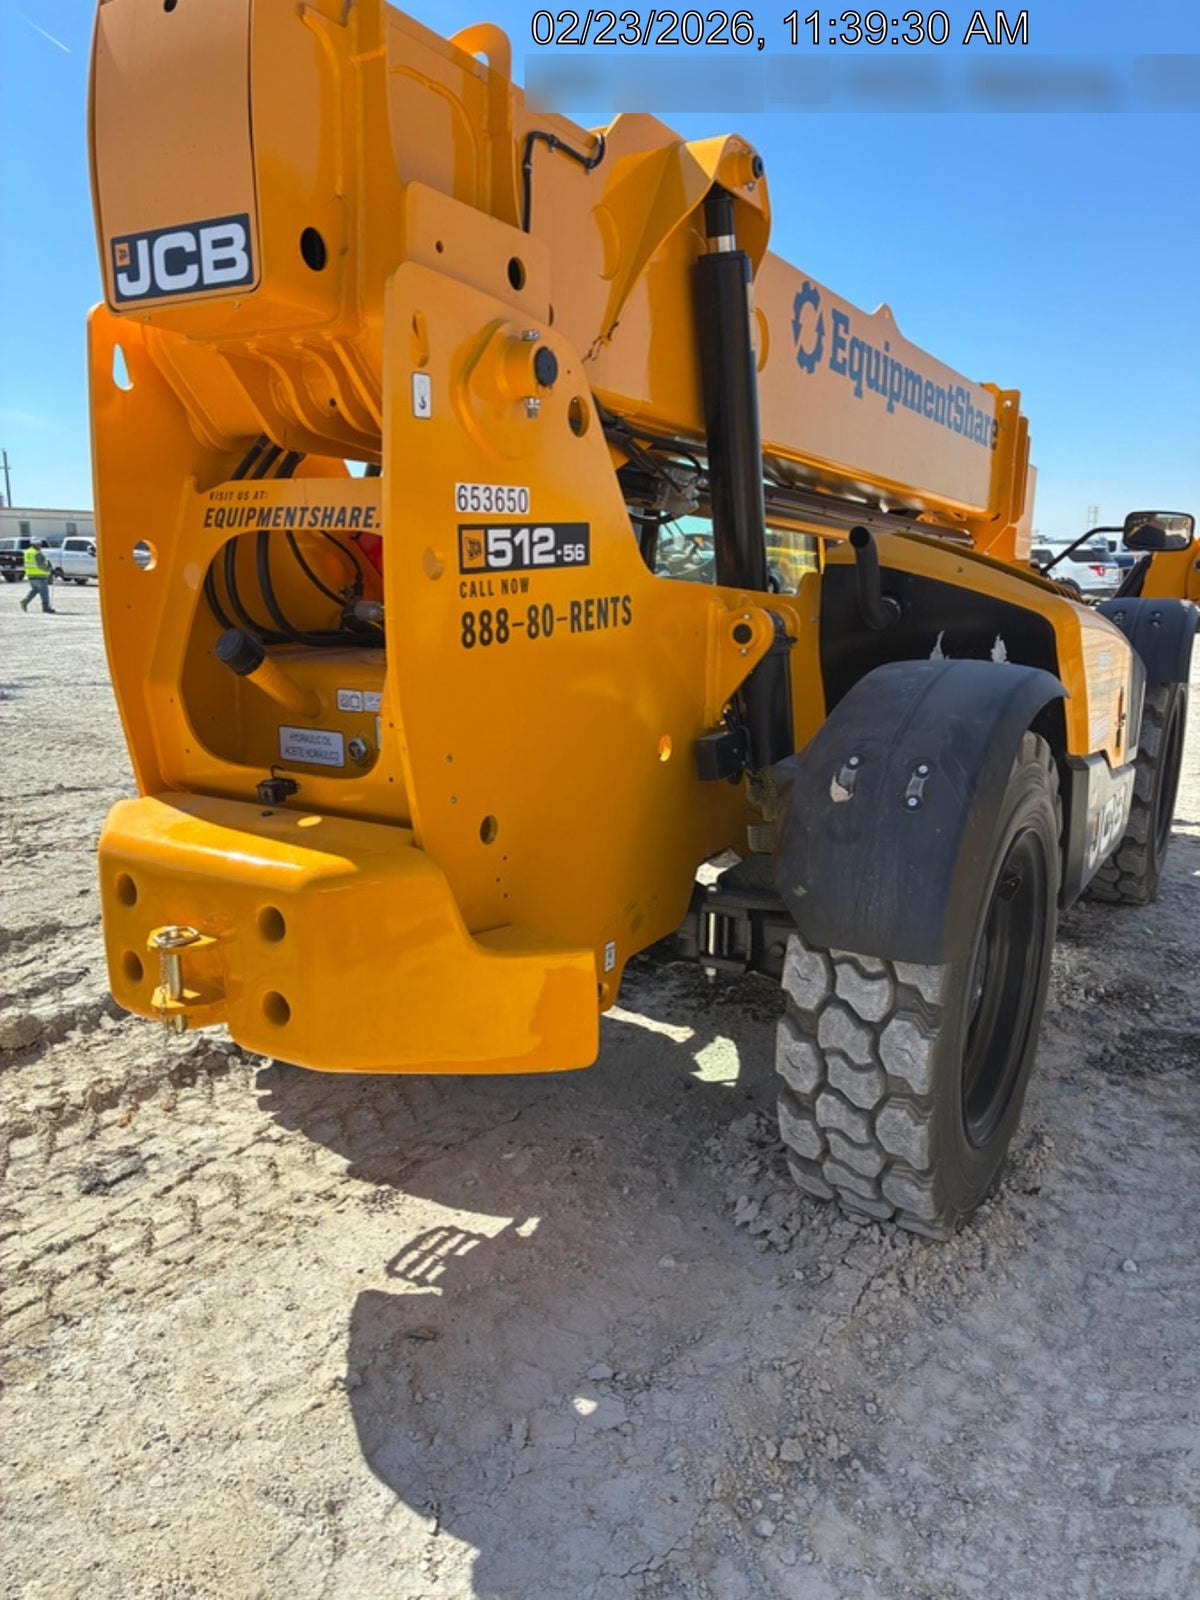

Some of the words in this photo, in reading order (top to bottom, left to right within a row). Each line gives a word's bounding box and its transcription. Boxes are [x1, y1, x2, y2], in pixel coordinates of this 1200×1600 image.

[117, 223, 249, 296] JCB
[829, 307, 999, 450] EquipmentShare
[209, 491, 234, 501] VISIT
[238, 491, 250, 500] US
[457, 484, 529, 513] 653650
[459, 580, 495, 599] CALL
[501, 577, 529, 595] NOW
[461, 594, 632, 650] 888-80-RENTS
